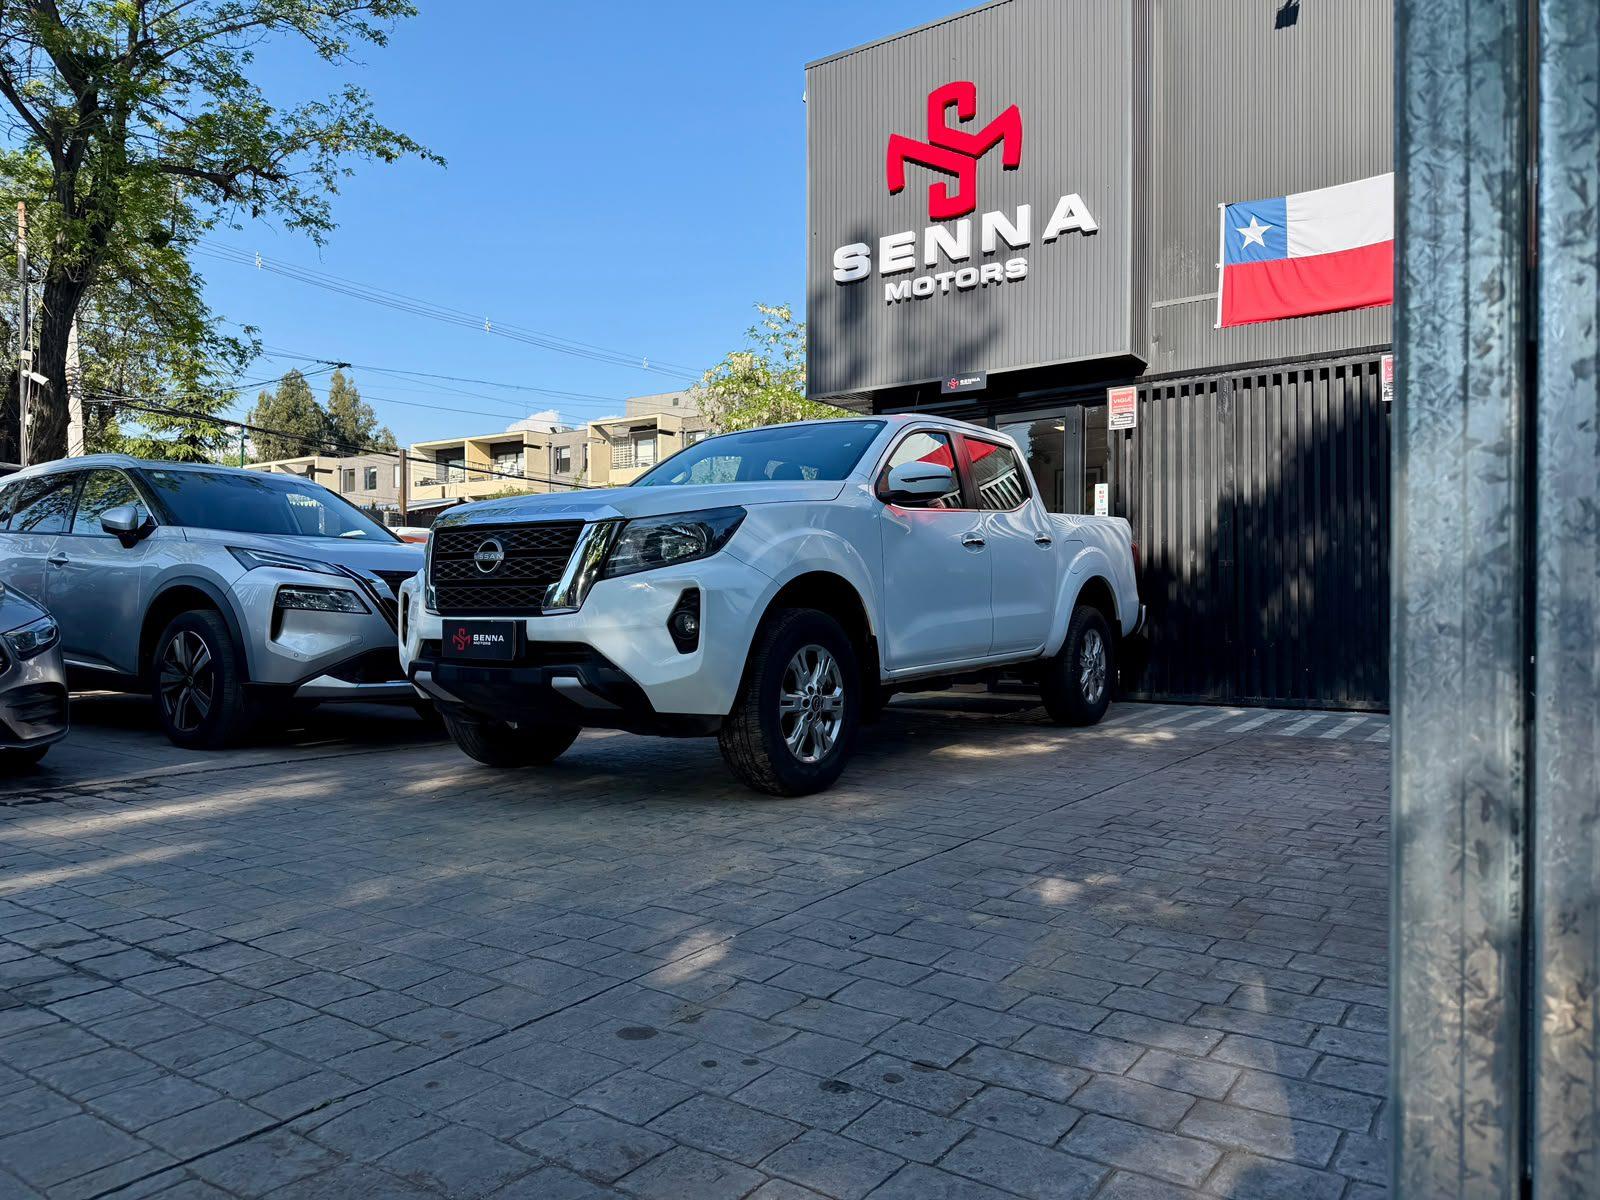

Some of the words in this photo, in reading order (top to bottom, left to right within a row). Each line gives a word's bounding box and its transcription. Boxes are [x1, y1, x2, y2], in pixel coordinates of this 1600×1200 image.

[832, 193, 1099, 284] SENNA
[884, 257, 1028, 304] MOTORS
[473, 634, 504, 642] SENNA
